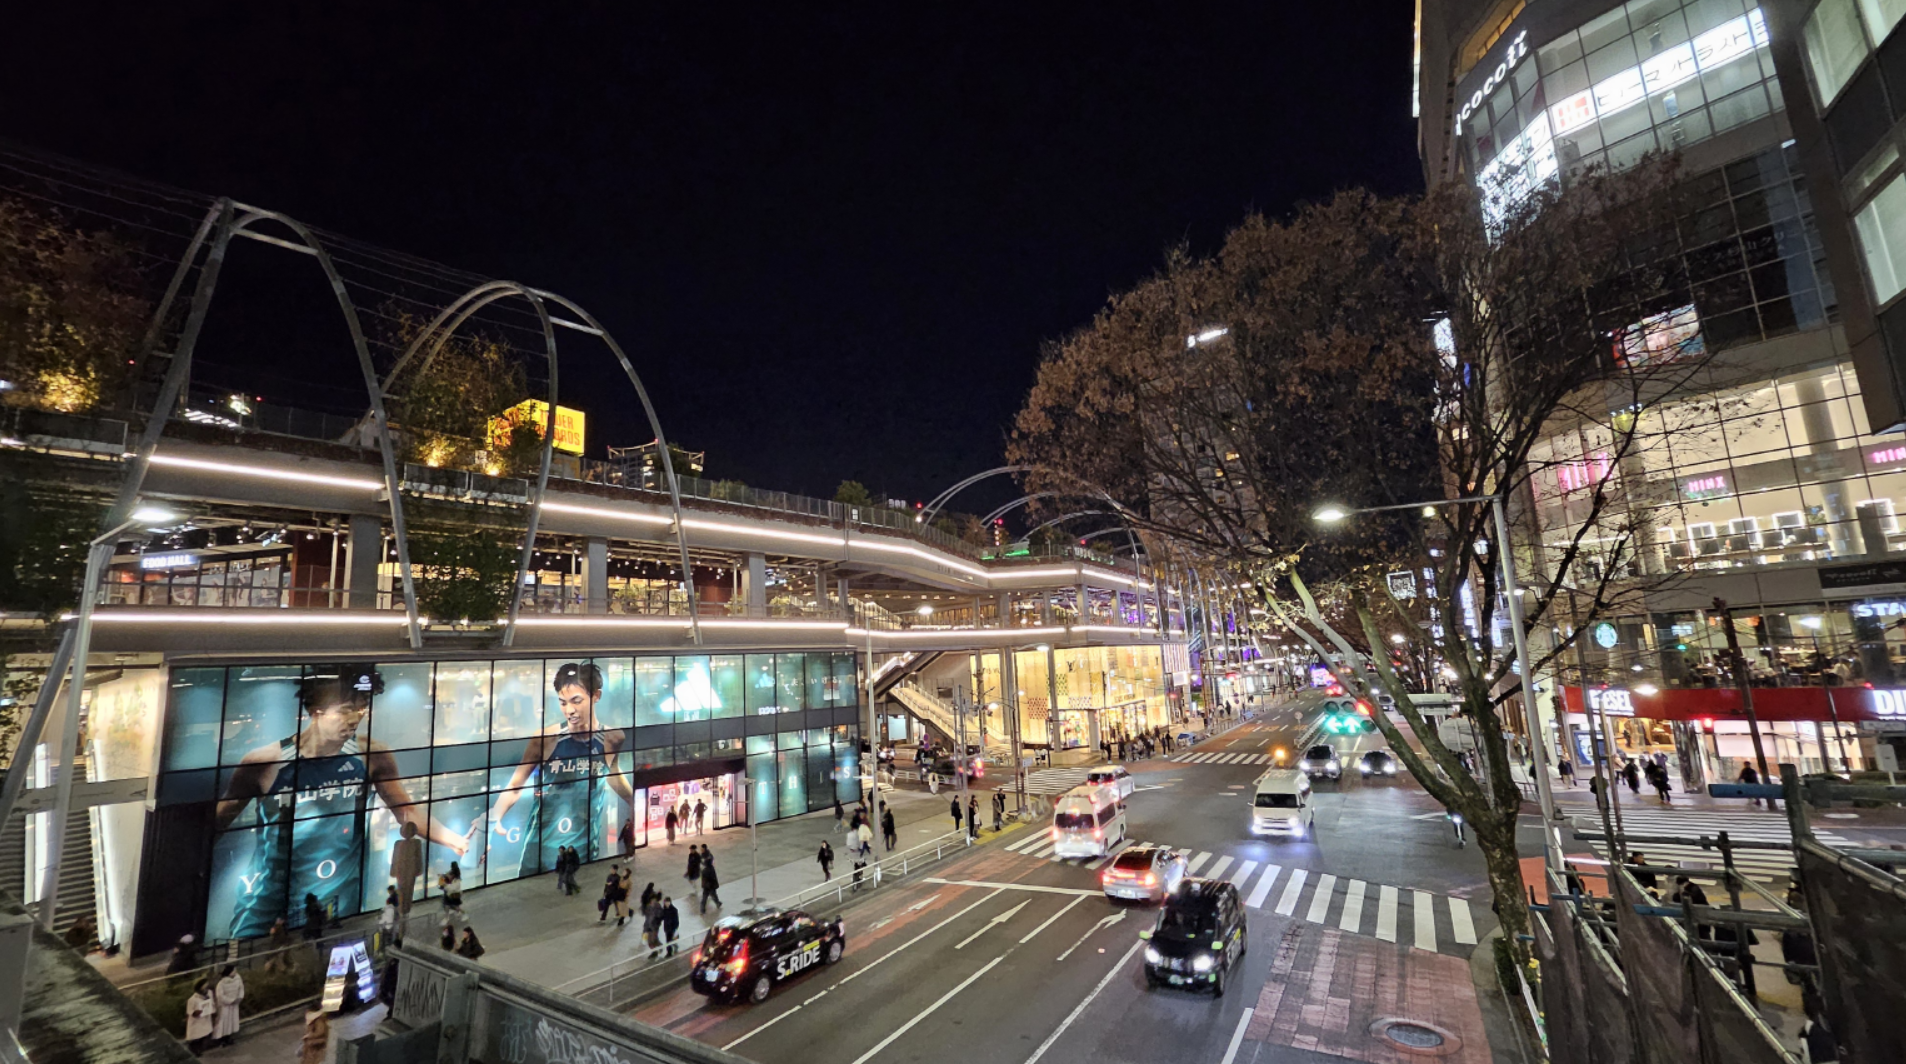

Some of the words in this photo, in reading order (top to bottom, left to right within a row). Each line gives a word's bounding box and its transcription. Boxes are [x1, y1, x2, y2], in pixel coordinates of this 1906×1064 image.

[540, 410, 574, 430] TER
[1688, 476, 1725, 493] MINX
[143, 556, 166, 569] FOOD
[167, 554, 191, 567] HALL
[1589, 689, 1634, 712] DESEL
[1873, 690, 1906, 714] DI
[274, 777, 364, 808] 青山学院
[776, 945, 821, 981] S.RIDE
